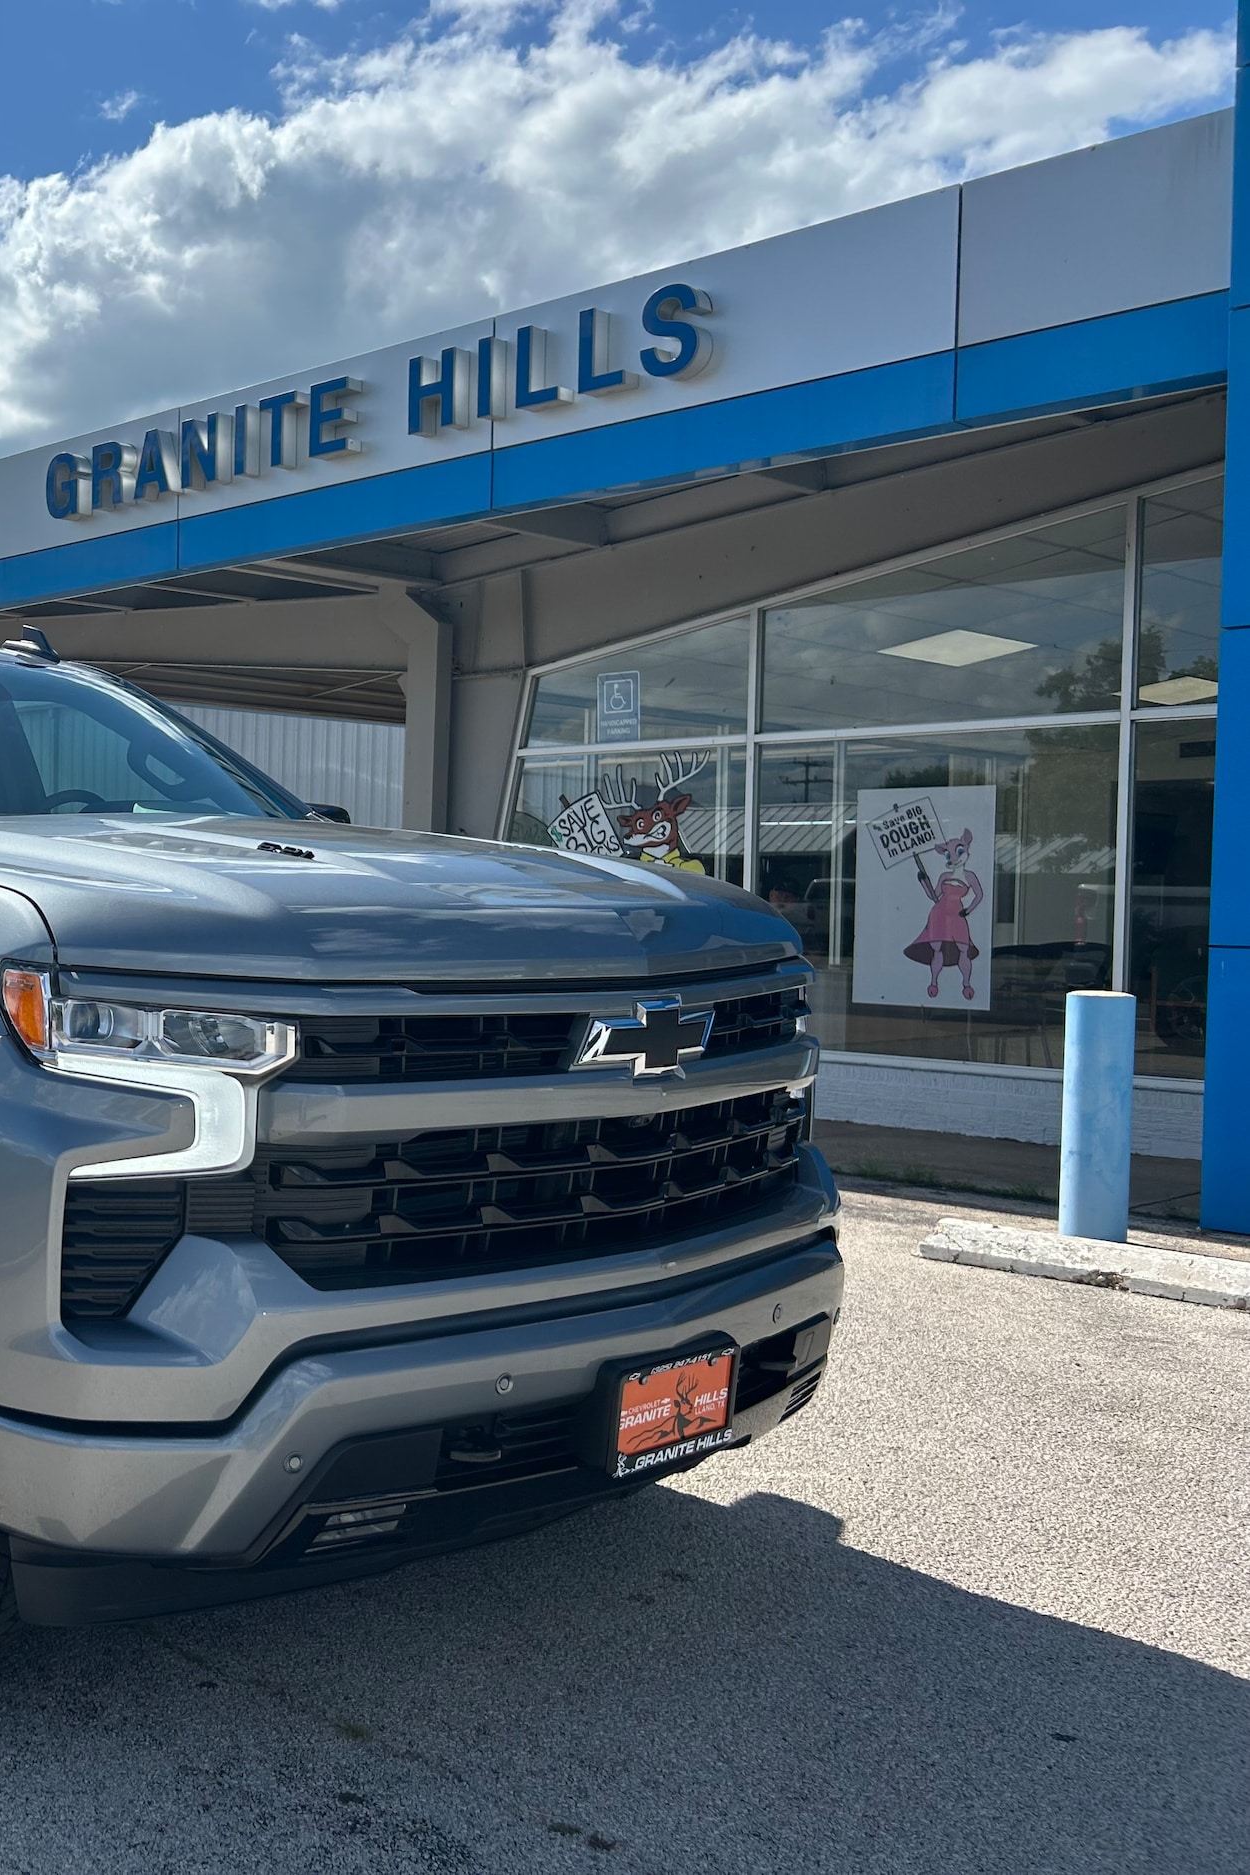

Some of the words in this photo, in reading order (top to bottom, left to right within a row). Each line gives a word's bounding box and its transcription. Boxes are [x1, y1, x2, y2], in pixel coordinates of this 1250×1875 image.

[47, 375, 363, 521] GRANITE
[408, 283, 713, 438] HILLS
[601, 718, 637, 727] HANDICAPPED
[607, 728, 630, 736] PARKING
[558, 797, 601, 837] SAVE
[882, 815, 906, 830] Save
[906, 805, 923, 820] BIG
[880, 814, 931, 849] DOUGH
[887, 847, 898, 858] in
[898, 829, 936, 853] LLANO!
[628, 1399, 661, 1414] CHEVROLET
[694, 1387, 728, 1408] HILLS
[717, 1400, 725, 1408] TX
[635, 1440, 695, 1470] GRANITE
[696, 1429, 733, 1451] HILLS
